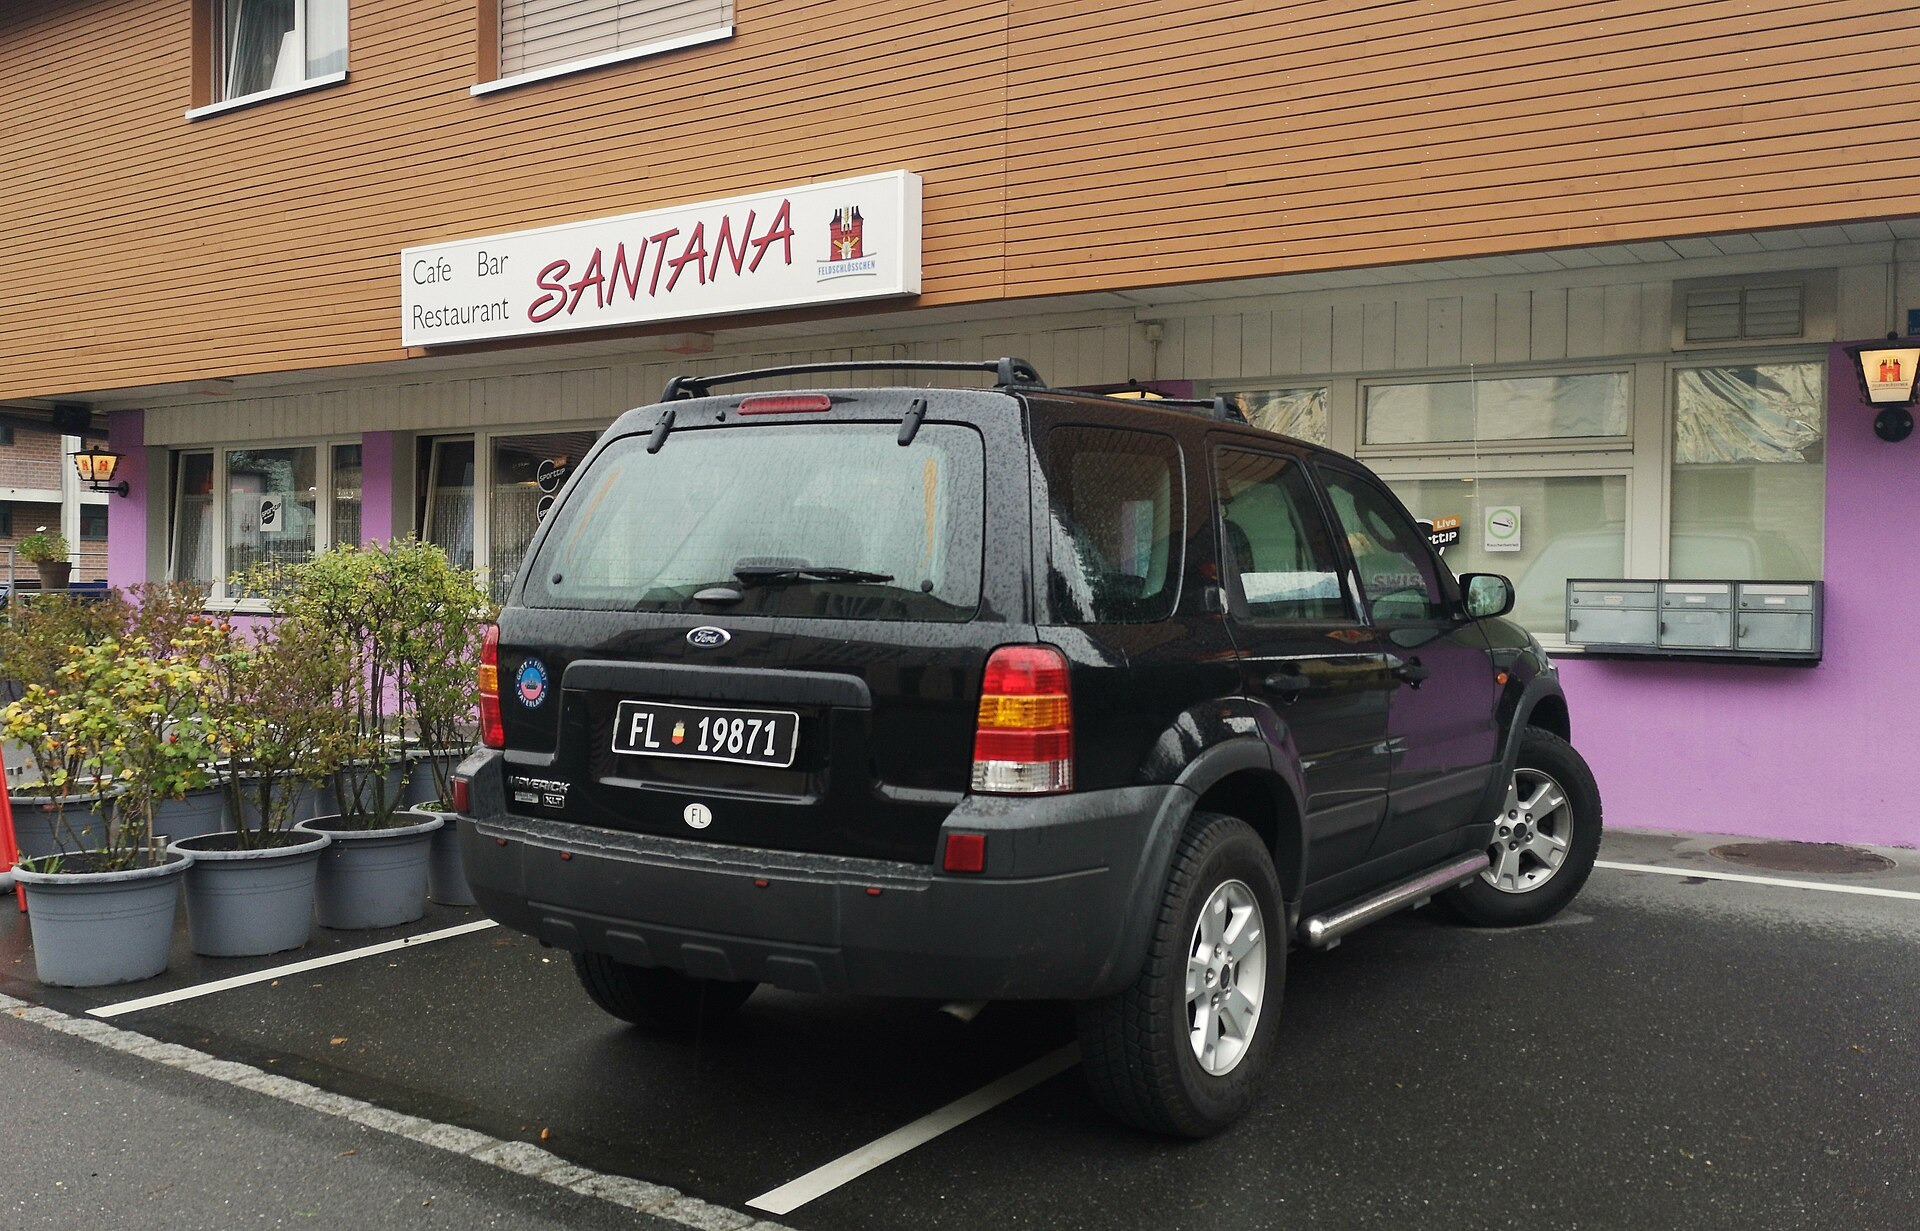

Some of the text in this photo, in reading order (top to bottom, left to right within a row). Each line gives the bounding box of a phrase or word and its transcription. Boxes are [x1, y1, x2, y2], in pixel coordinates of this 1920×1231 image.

[413, 250, 510, 286] Cafe Bar
[527, 198, 795, 324] SANTANA
[818, 260, 876, 276] FELDSCHLÖSSCHEN
[412, 298, 510, 330] Restaurant
[1436, 519, 1457, 529] Live
[694, 630, 719, 644] Ford
[517, 660, 547, 681] GOTT FÜRST
[517, 690, 546, 708] VATERLAND
[629, 713, 775, 756] FL 19871
[545, 795, 562, 805] XLT
[691, 807, 705, 824] FL
